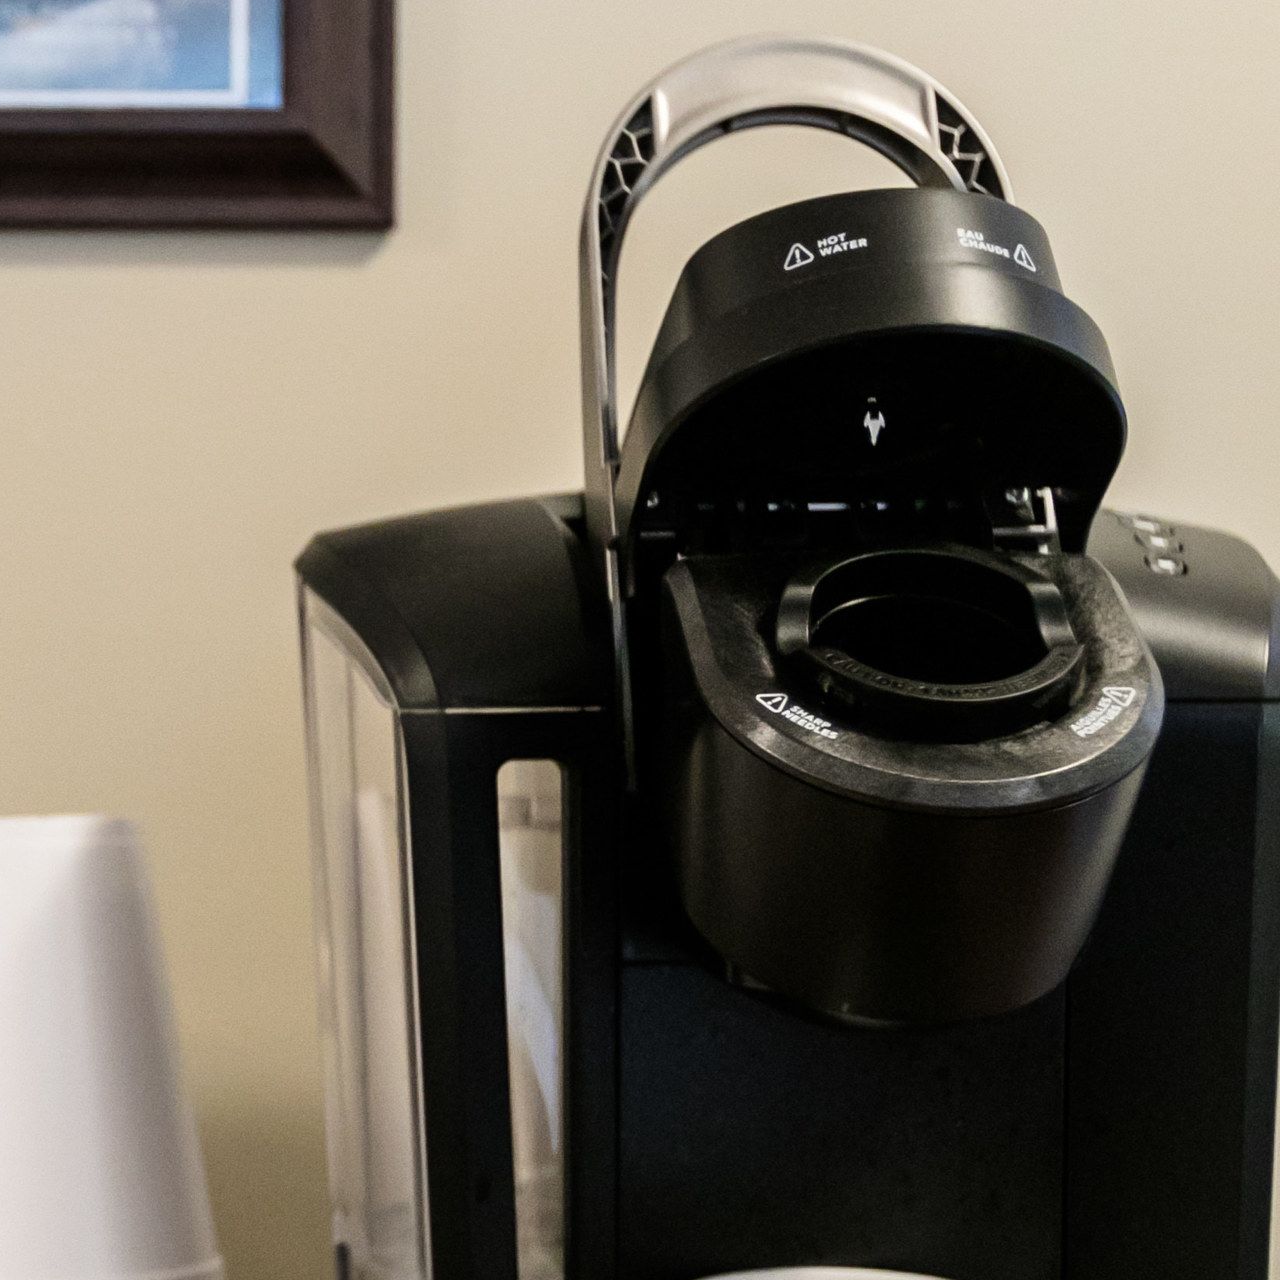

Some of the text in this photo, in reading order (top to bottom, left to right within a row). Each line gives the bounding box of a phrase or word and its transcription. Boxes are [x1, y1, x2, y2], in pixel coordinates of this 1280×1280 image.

[817, 232, 847, 248] HOT
[819, 237, 868, 257] WATER
[959, 237, 1010, 258] CHAUDE
[781, 709, 839, 739] NEEDLES
[790, 705, 831, 728] SHARP
